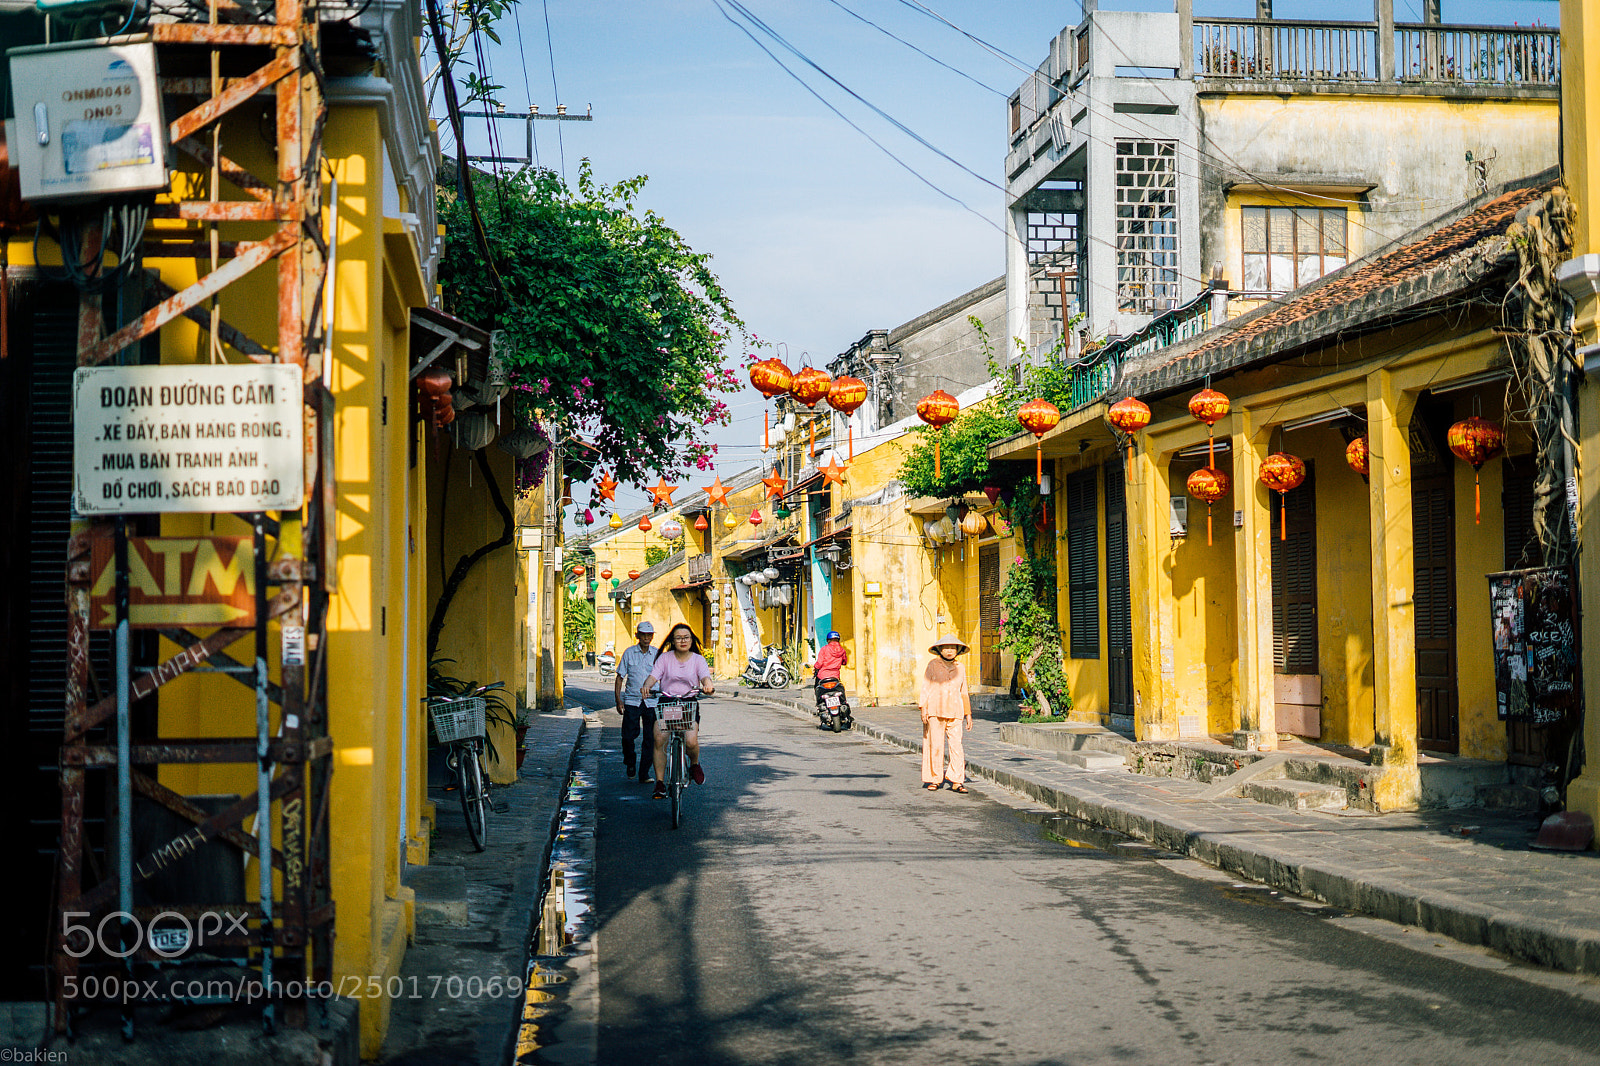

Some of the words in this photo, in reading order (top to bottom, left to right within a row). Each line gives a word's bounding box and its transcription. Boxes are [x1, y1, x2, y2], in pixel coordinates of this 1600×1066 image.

[101, 386, 153, 412] ĐOẠN
[160, 379, 225, 406] ĐƯỜNG
[232, 379, 275, 405] CẤM
[176, 452, 222, 468] TRANH
[91, 539, 256, 596] ATM
